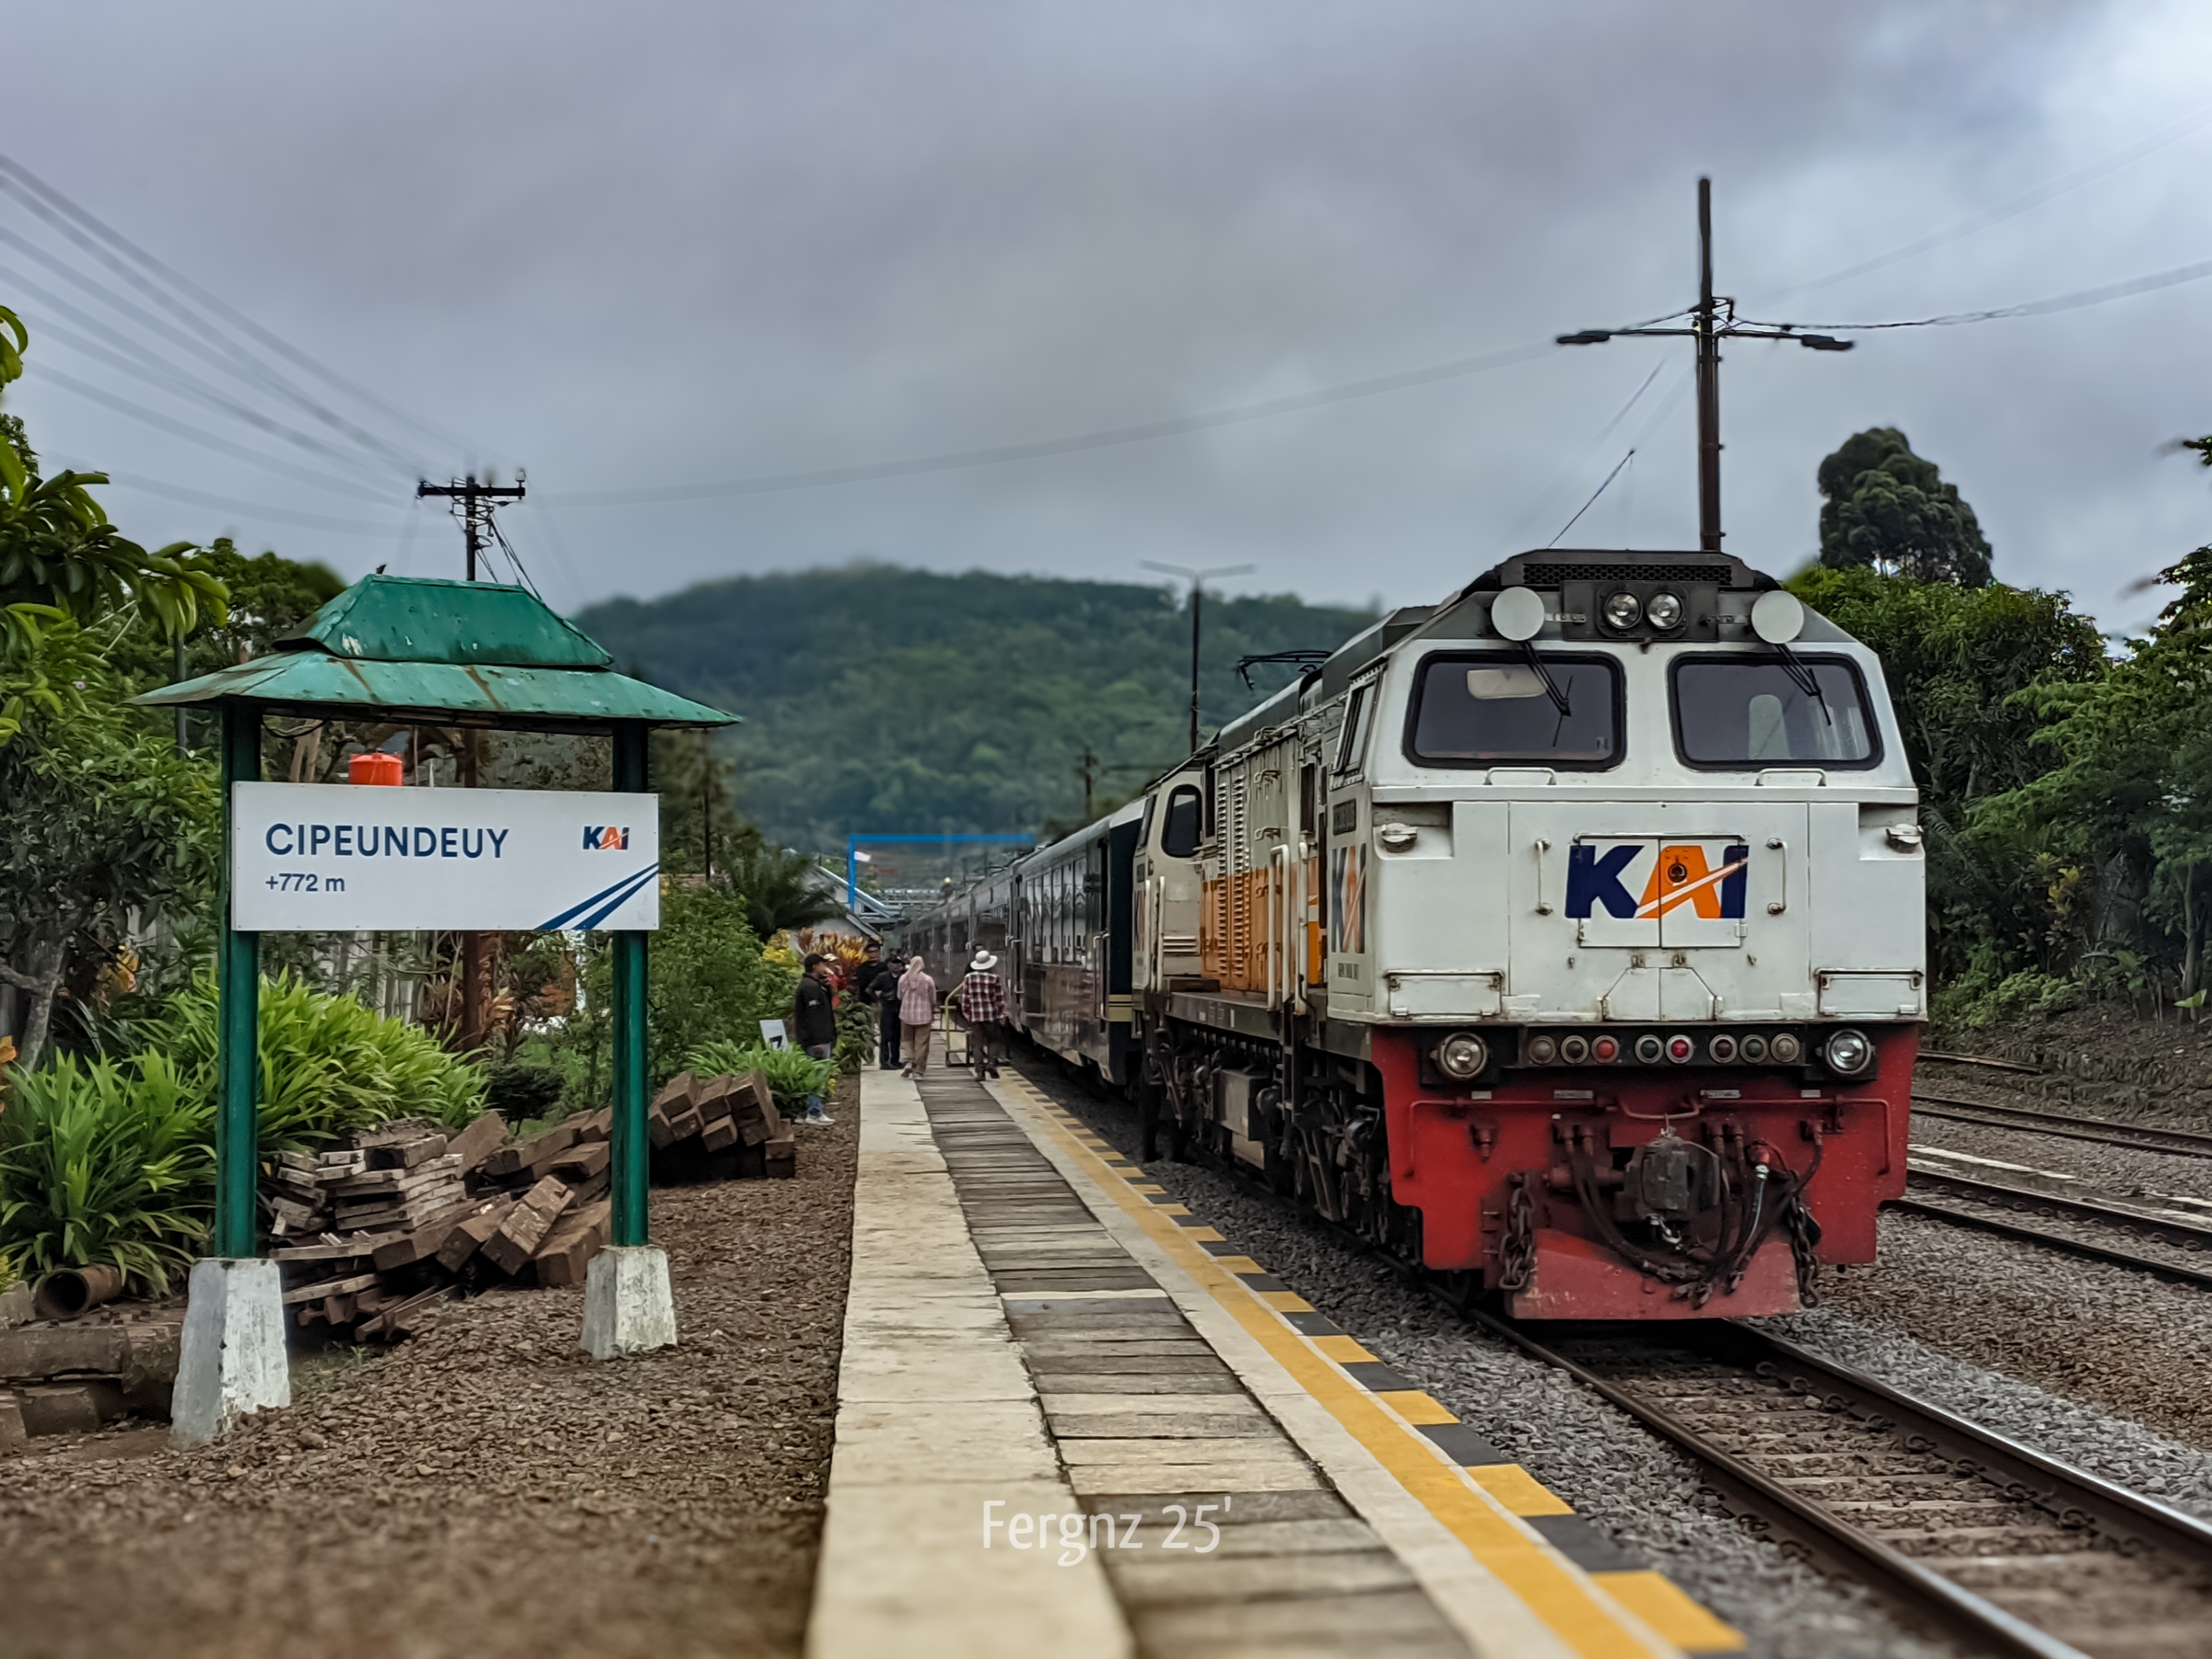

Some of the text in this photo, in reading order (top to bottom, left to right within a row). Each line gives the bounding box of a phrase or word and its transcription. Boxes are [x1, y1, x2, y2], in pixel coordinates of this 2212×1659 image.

[265, 823, 510, 859] CIPEUNDEUY
[582, 825, 630, 851] KAI
[265, 873, 346, 892] +772 m
[1331, 844, 1367, 954] KAI
[1565, 845, 1749, 919] KAI
